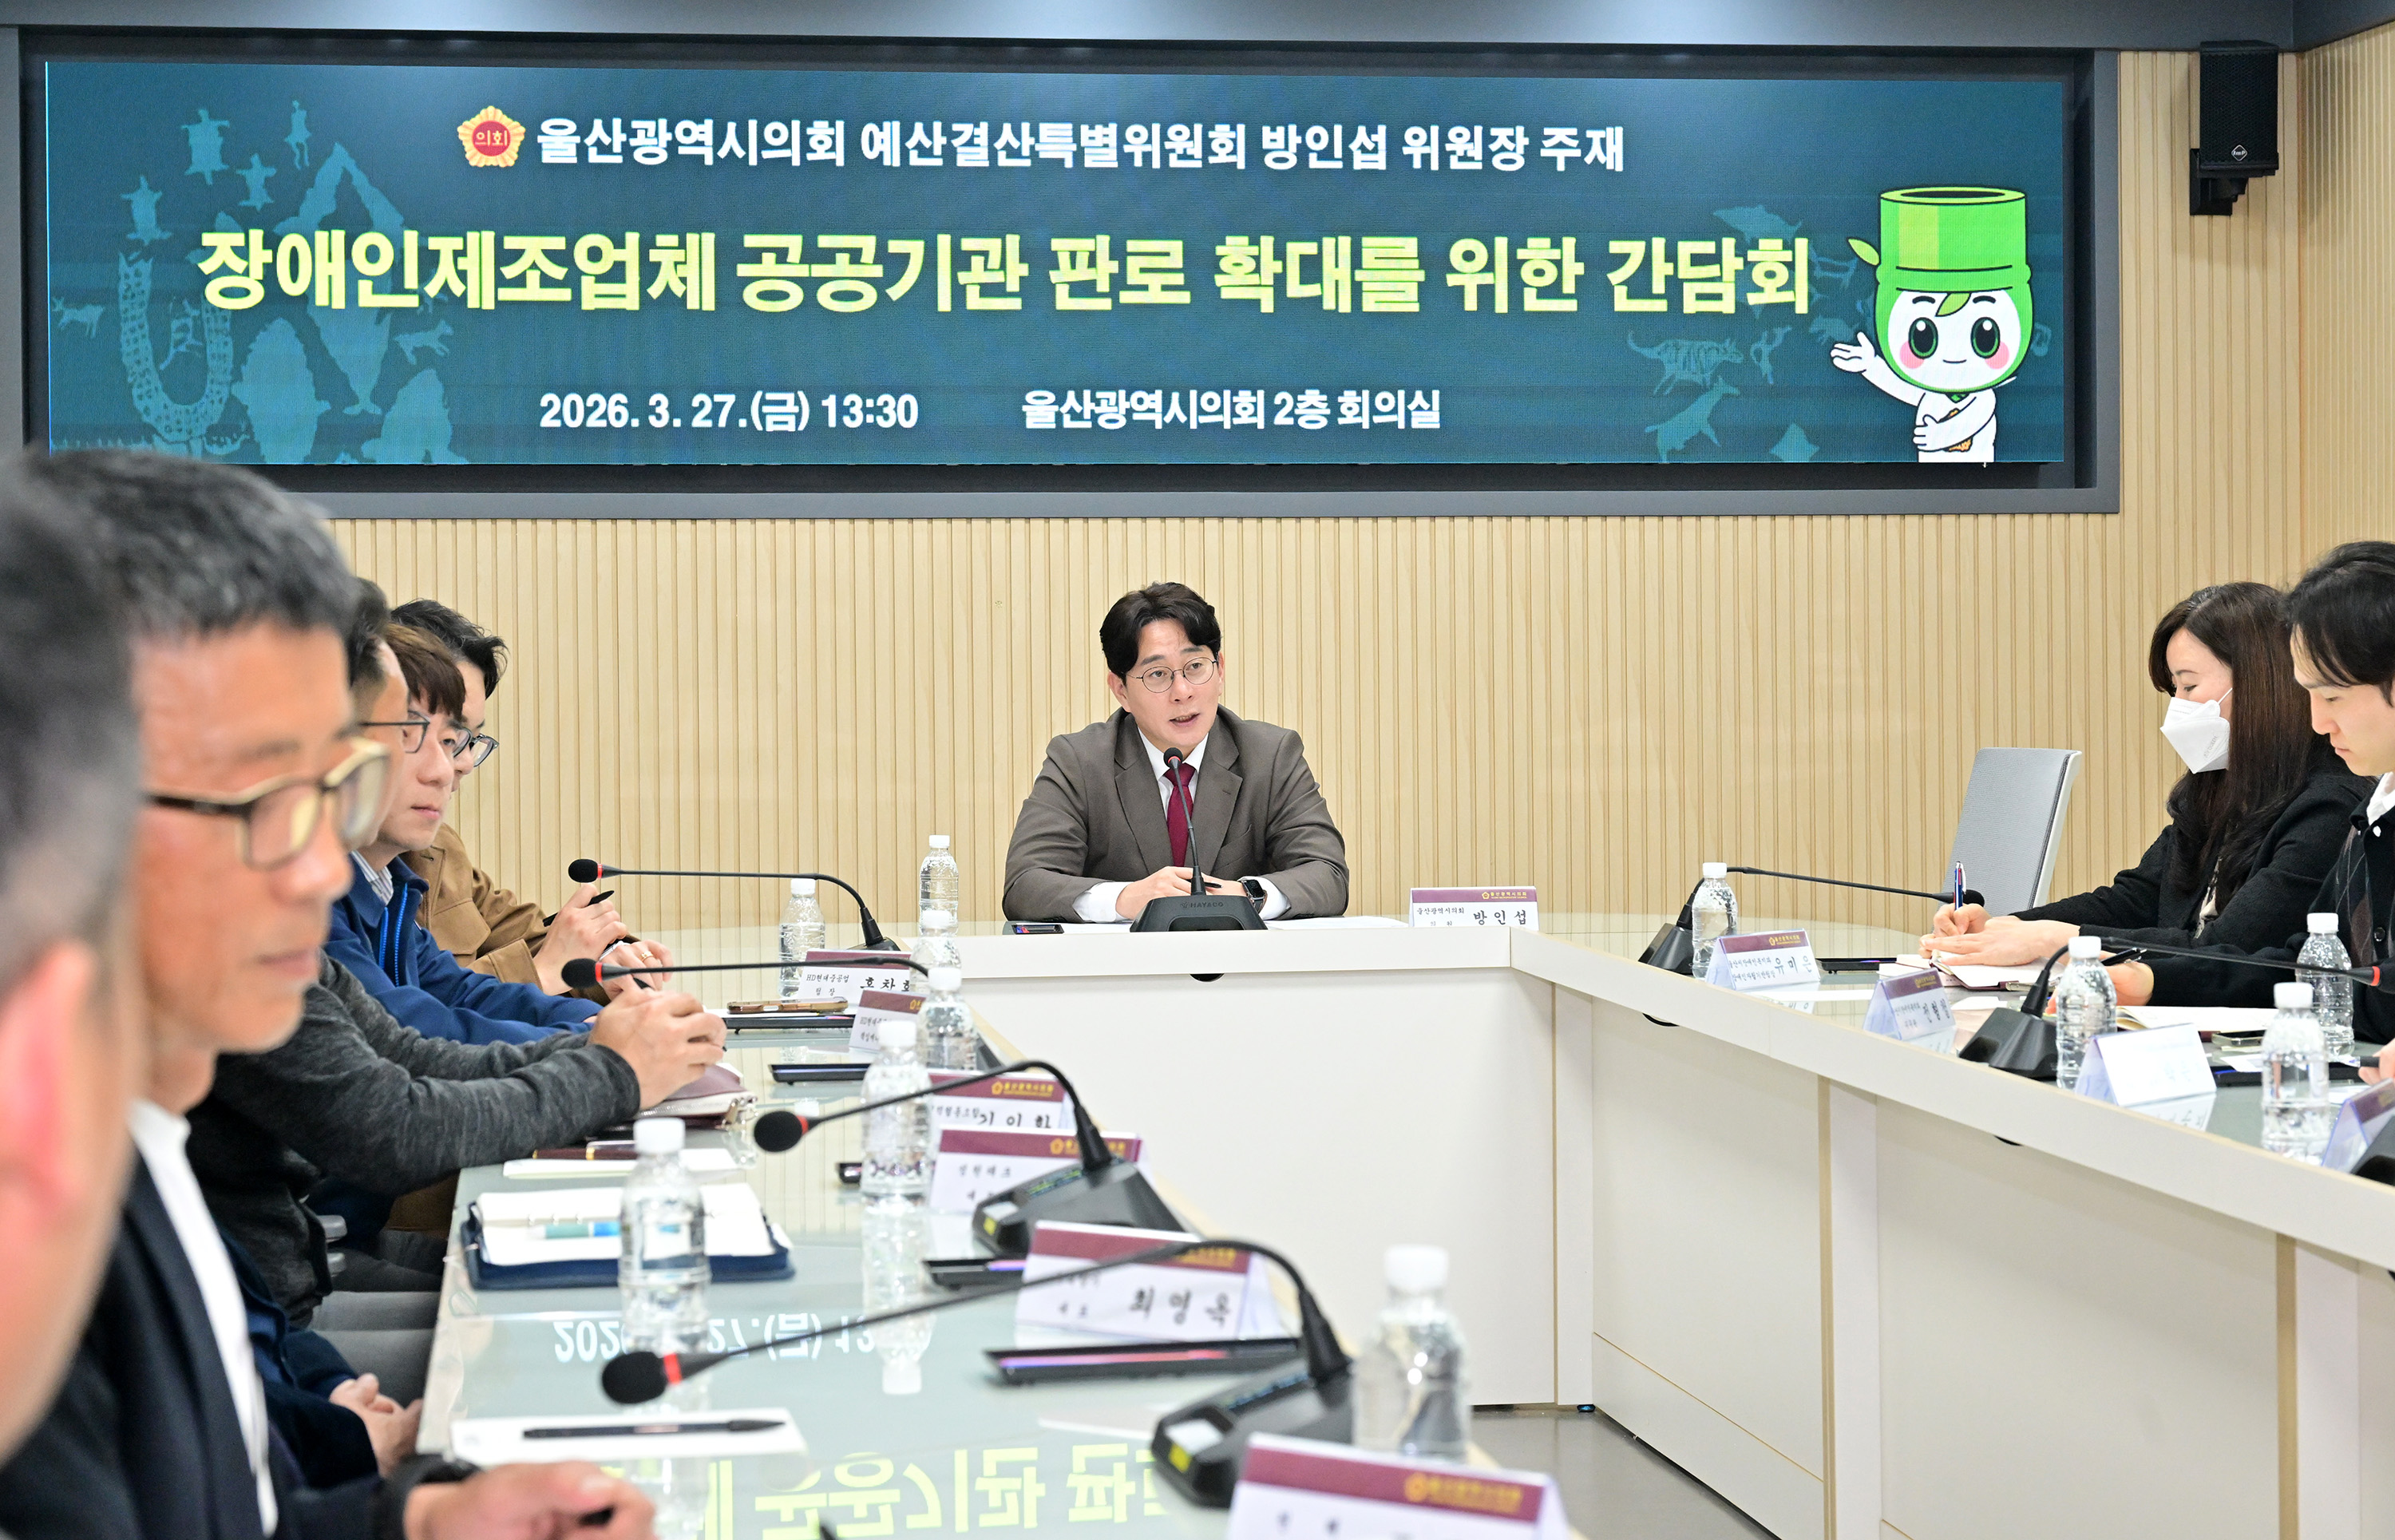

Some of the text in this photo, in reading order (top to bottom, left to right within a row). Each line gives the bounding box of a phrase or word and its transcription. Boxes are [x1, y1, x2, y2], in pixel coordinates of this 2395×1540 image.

[475, 129, 508, 146] 의회
[537, 118, 1625, 172] 울산광역시의회 예산결산특별위원회 방인섭 위원장 주재
[197, 228, 1809, 315] 장애인제조업체 공공기관 판로 확대를 위한 간담회
[540, 394, 641, 429] 2026.
[648, 394, 683, 429] 3.
[821, 394, 920, 430] 13:30
[1023, 390, 1442, 430] 울산광역시의회 2층 회의실
[1416, 906, 1465, 916] 울산광역시의회
